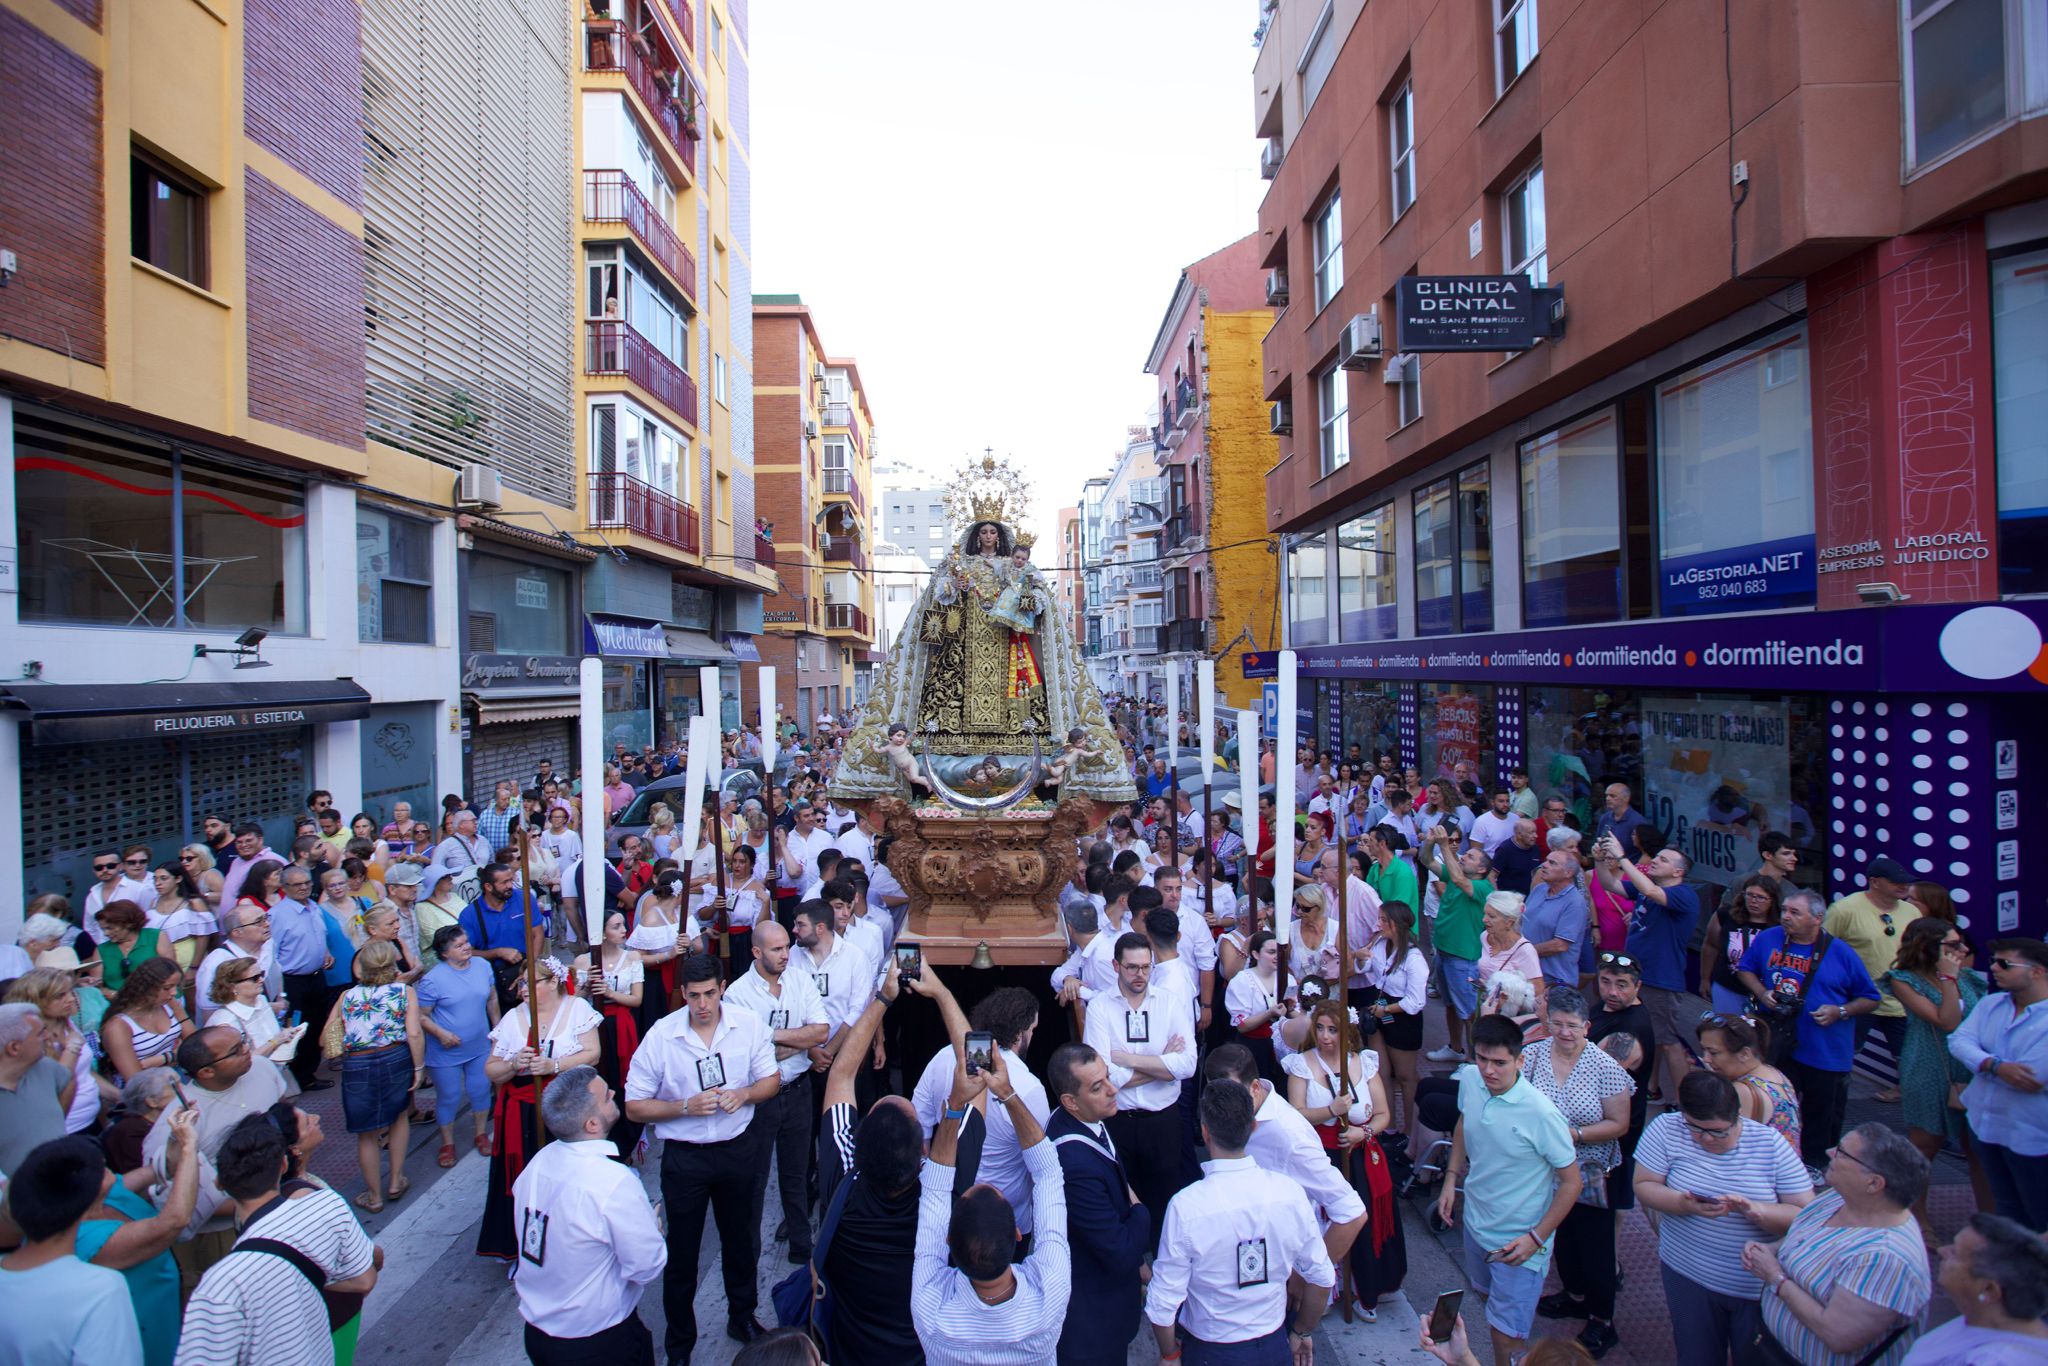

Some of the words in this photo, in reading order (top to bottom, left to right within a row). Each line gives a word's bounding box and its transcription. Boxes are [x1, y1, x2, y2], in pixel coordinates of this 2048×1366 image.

[1416, 281, 1518, 294] CLINICA
[1420, 298, 1516, 311] DENTAL
[1819, 538, 1882, 560] ASESORÍA
[1894, 531, 1988, 549] LABORAL
[1817, 555, 1885, 574] EMPRESAS
[1698, 584, 1719, 599] 952
[1721, 582, 1742, 597] 040
[1744, 579, 1767, 594] 683
[1341, 655, 1373, 668] dormitienda
[1379, 654, 1419, 668] dormitienda
[1428, 651, 1481, 667] dormitienda
[1490, 647, 1560, 667] dormitienda
[1575, 644, 1677, 667] dormitienda
[1703, 638, 1864, 666] dormitienda
[154, 714, 236, 732] PELUQUERIA
[240, 713, 249, 725] &
[254, 710, 305, 724] ESTETICA
[1646, 710, 1659, 736] TU
[1662, 711, 1698, 739] EQUIPO
[1702, 714, 1716, 741] DE
[1719, 715, 1785, 747] DESCANSO
